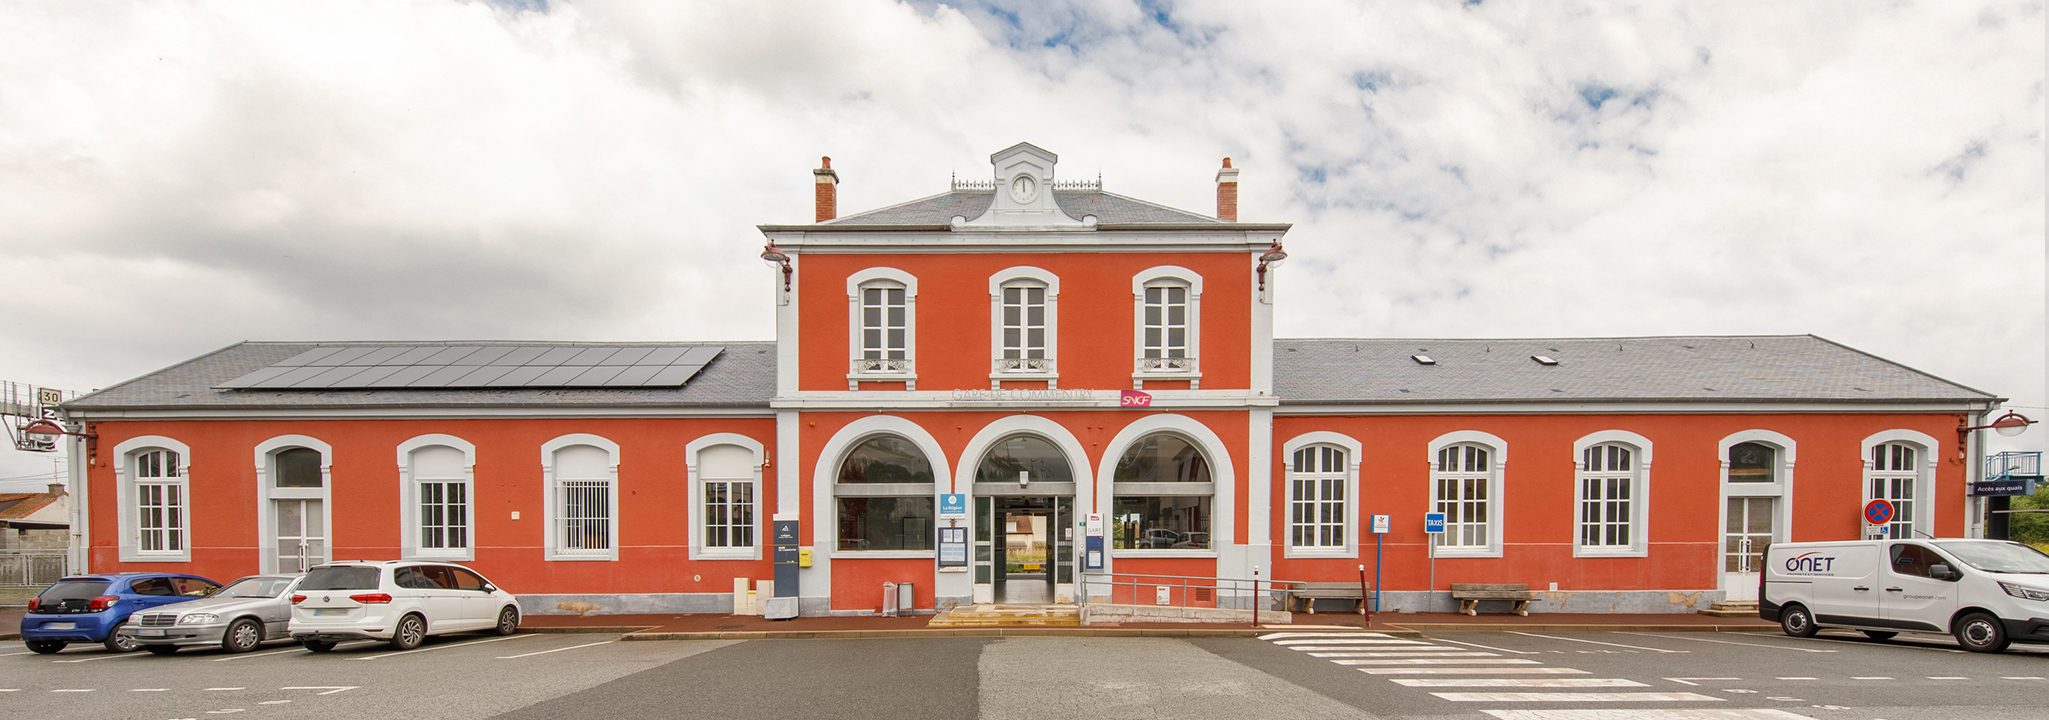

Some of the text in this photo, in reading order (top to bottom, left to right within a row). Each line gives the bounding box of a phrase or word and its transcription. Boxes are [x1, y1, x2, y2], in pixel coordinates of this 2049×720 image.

[44, 392, 58, 402] 30
[952, 389, 1094, 401] GARE DE COMMENTRY
[1122, 396, 1150, 405] SNCF
